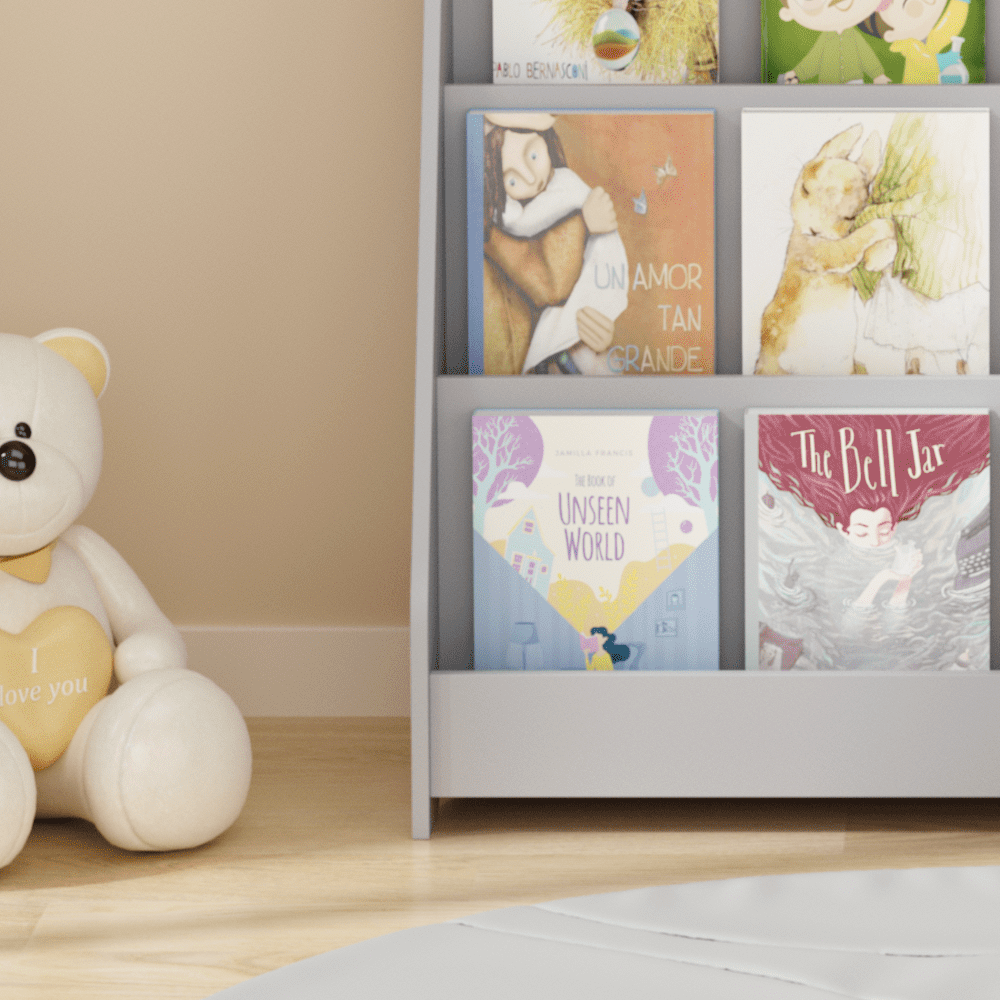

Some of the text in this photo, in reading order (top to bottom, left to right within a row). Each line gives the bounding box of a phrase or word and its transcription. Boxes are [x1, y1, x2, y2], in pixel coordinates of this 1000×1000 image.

[526, 60, 589, 80] BERNASCONI
[593, 261, 703, 291] UN AMOR
[656, 303, 702, 332] TAN
[606, 344, 705, 373] GRANDE
[790, 426, 946, 498] The Bell Jar
[558, 491, 631, 526] UNSEEN
[563, 526, 626, 562] WORLD
[30, 647, 38, 674] I
[0, 676, 89, 707] love you
